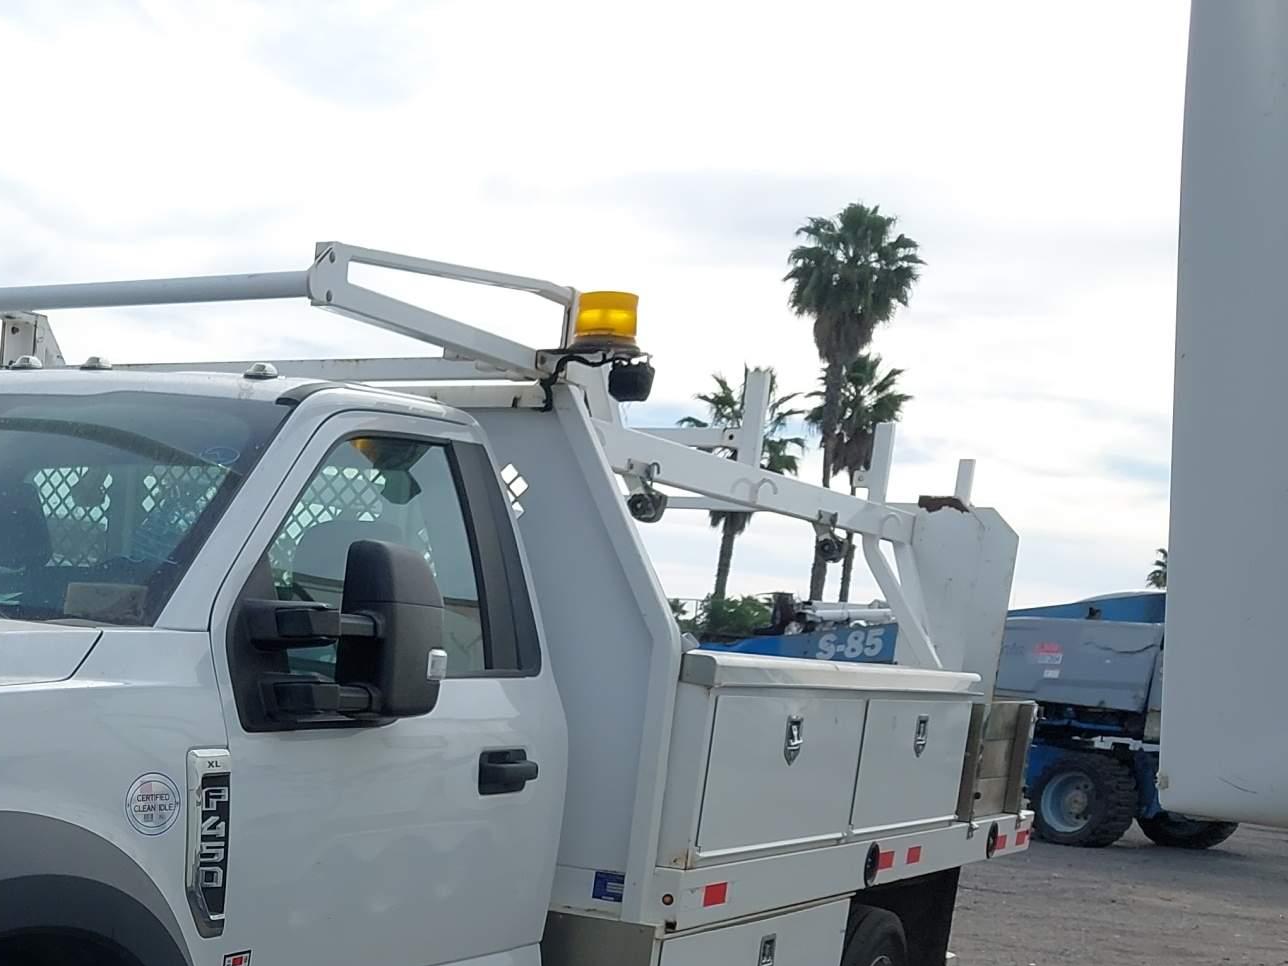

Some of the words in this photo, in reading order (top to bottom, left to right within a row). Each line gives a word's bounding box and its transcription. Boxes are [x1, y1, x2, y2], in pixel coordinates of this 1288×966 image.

[815, 628, 886, 660] S-85
[207, 760, 221, 769] XL
[136, 793, 170, 803] CERTIFIED
[133, 804, 156, 813] CLEAN
[158, 802, 175, 812] IDLE
[199, 786, 229, 888] F450
